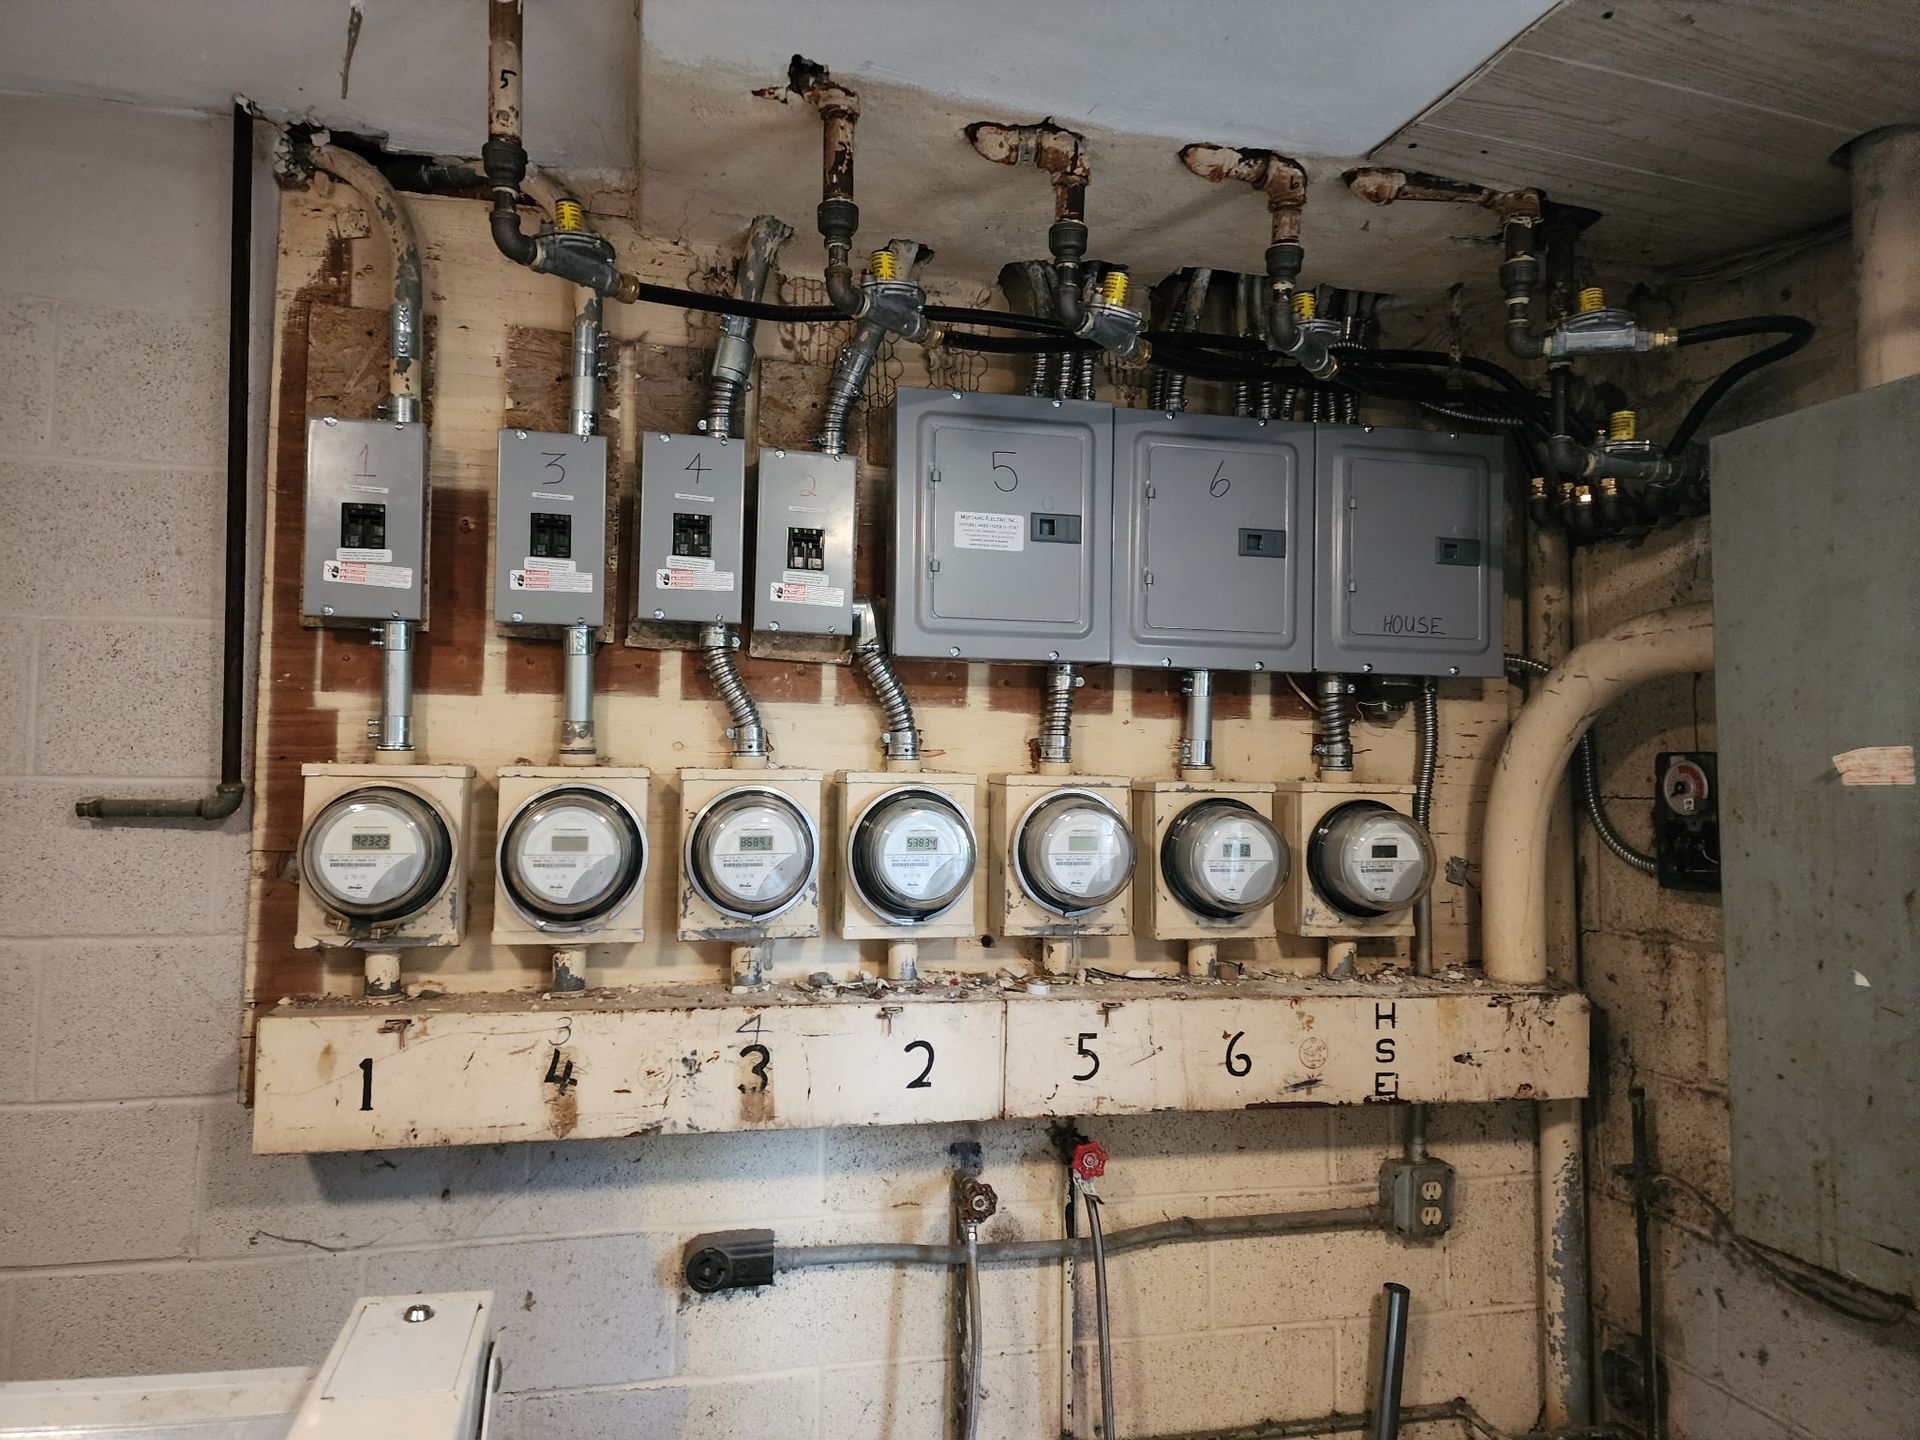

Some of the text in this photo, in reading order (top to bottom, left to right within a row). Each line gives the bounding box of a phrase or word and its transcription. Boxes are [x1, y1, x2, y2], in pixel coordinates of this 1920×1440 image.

[499, 69, 517, 90] 5
[352, 443, 377, 477] 1
[541, 451, 567, 485] 3
[684, 452, 712, 484] 4
[991, 451, 1019, 492] 5
[799, 474, 818, 497] 2
[1209, 460, 1231, 498] 6
[1383, 614, 1447, 635] HOUSE
[548, 1016, 573, 1046] 3
[735, 1014, 773, 1044] 4
[543, 1048, 578, 1096] 4
[737, 1044, 772, 1095] 3
[904, 1040, 936, 1090] 2
[1071, 1032, 1101, 1082] 5
[1225, 1031, 1253, 1078] 6
[357, 1057, 375, 1111] 1
